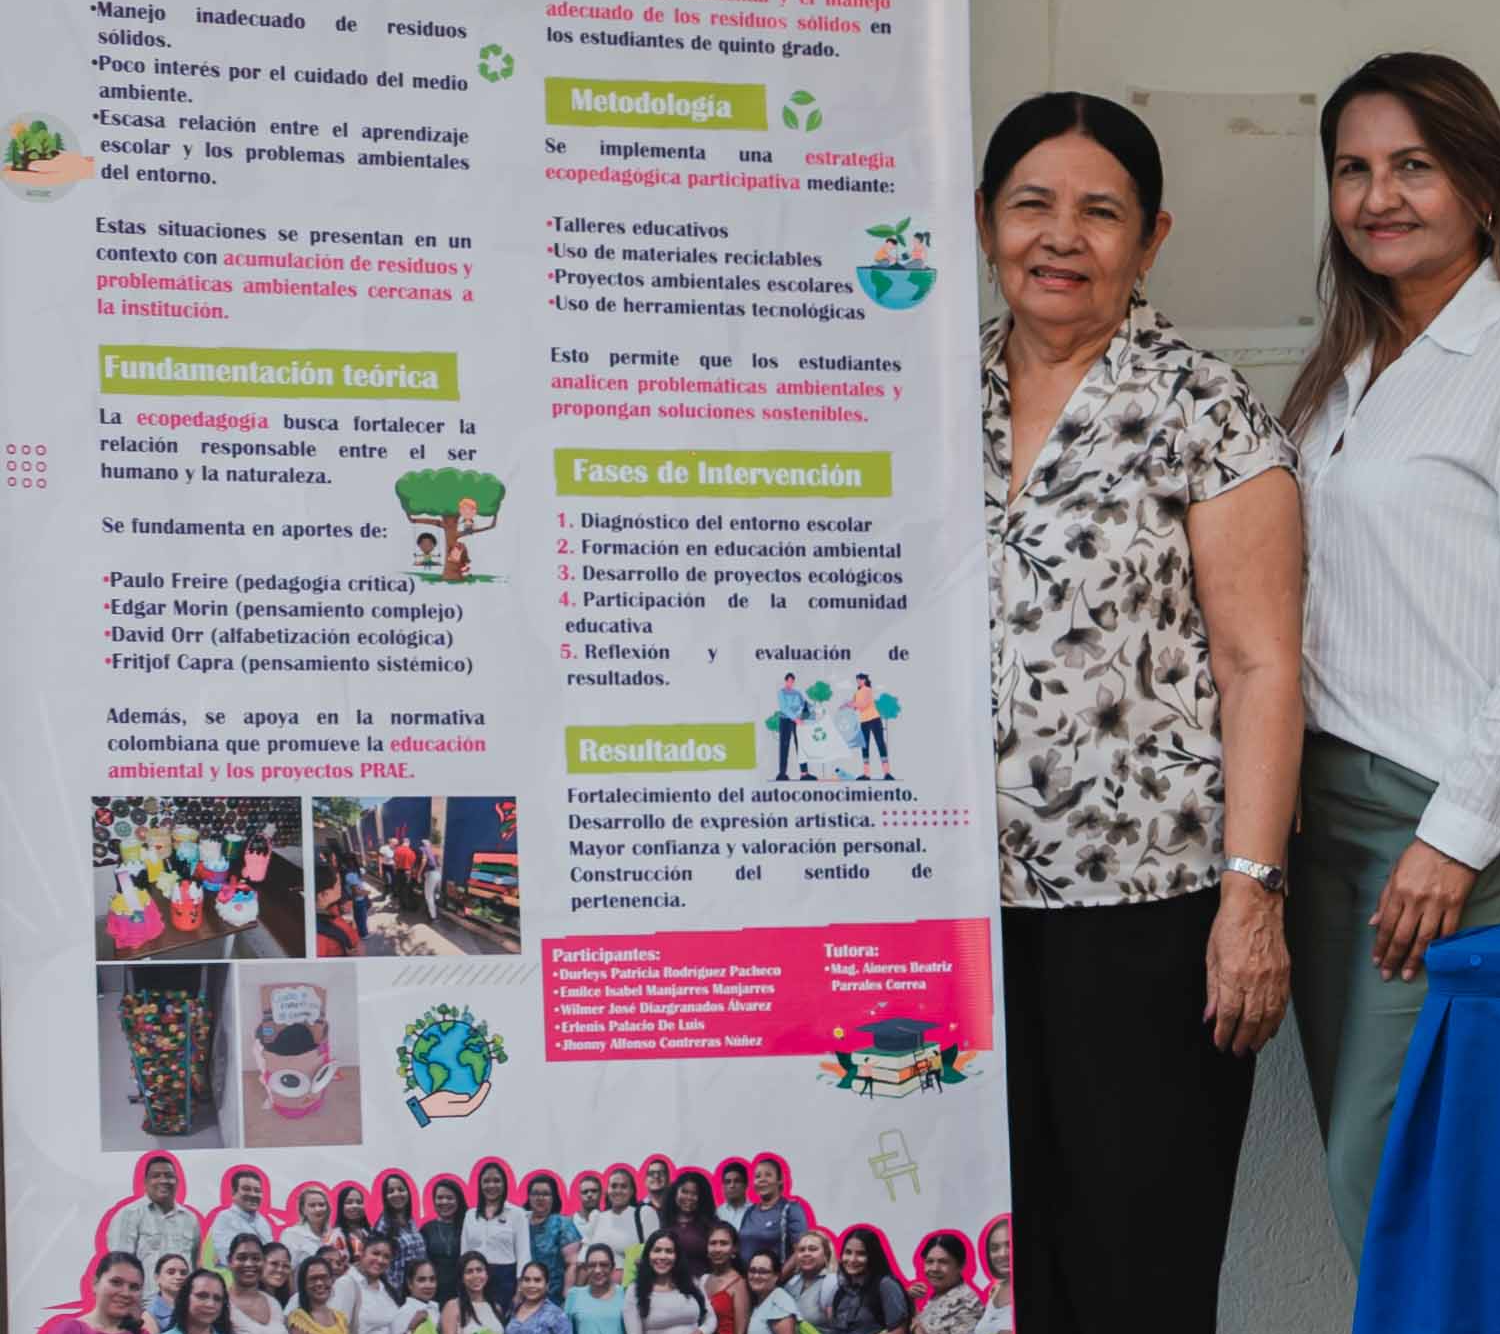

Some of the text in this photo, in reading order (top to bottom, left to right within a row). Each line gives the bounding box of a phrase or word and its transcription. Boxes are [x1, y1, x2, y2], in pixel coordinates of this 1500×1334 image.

[103, 354, 439, 390] Fundamentación teórica
[573, 458, 862, 487] Fases de Intervención
[110, 571, 164, 588] Paulo
[171, 572, 228, 589] Freire
[111, 598, 463, 623] Edgar Morin (pensamiento complejo)
[111, 625, 453, 649] David Orr (alfabetización ecológica)
[112, 652, 473, 675] Fritjof Capra (pensamiento sistémico)
[578, 738, 727, 763] Resultados
[552, 947, 660, 965] Participantes:
[824, 943, 879, 958] Tutora:
[885, 978, 927, 990] Correa
